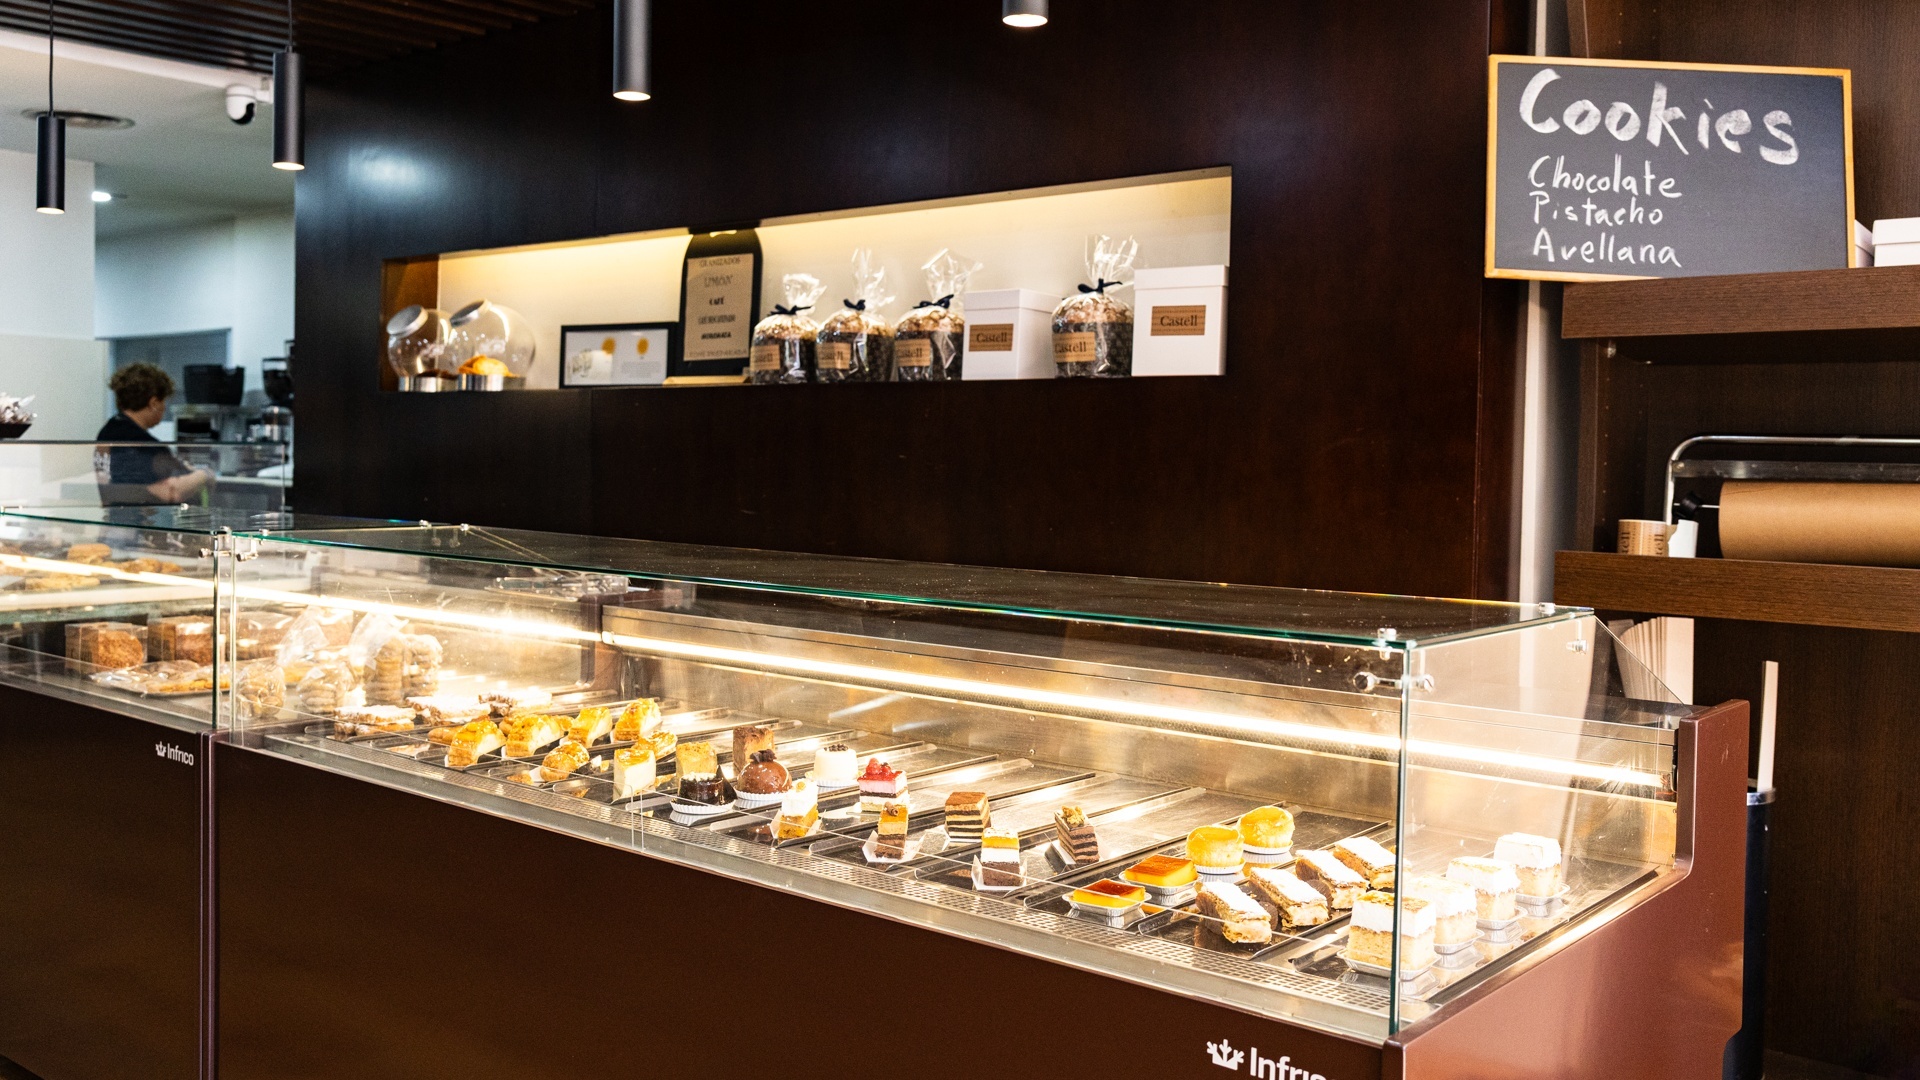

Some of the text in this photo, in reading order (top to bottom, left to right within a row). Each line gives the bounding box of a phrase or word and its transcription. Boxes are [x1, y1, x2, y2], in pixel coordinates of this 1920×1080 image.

[1519, 68, 1800, 165] Cookies
[1528, 154, 1682, 198] Chocolate
[1529, 190, 1664, 226] Pistacho
[1533, 227, 1682, 268] Avellana
[1160, 316, 1198, 327] Castell
[976, 332, 1008, 343] Castell
[1055, 341, 1087, 353] Castell
[167, 743, 194, 766] Infrico
